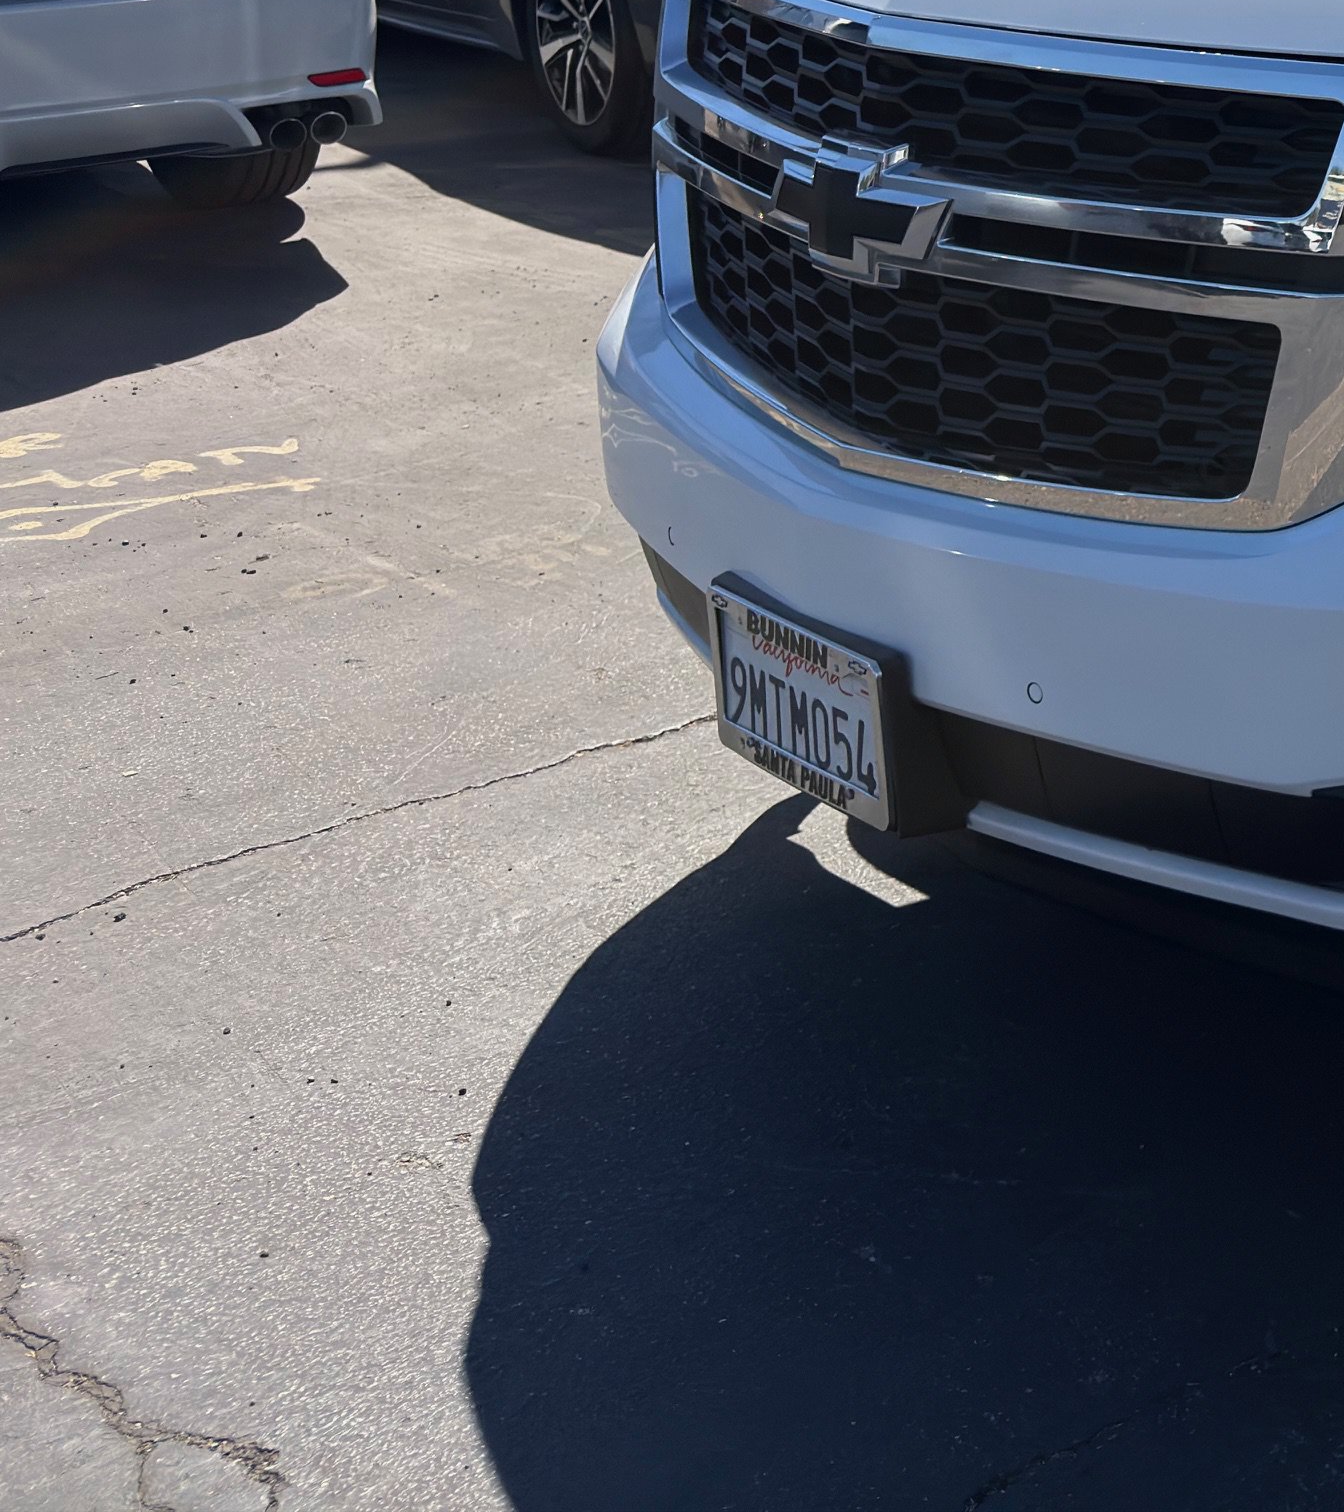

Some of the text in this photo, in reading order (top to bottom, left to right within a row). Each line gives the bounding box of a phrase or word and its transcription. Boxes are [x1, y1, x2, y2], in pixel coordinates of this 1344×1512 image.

[747, 608, 828, 669] BUNNIN
[730, 656, 877, 796] 9MTM054
[754, 745, 847, 810] SANTA PAULA
